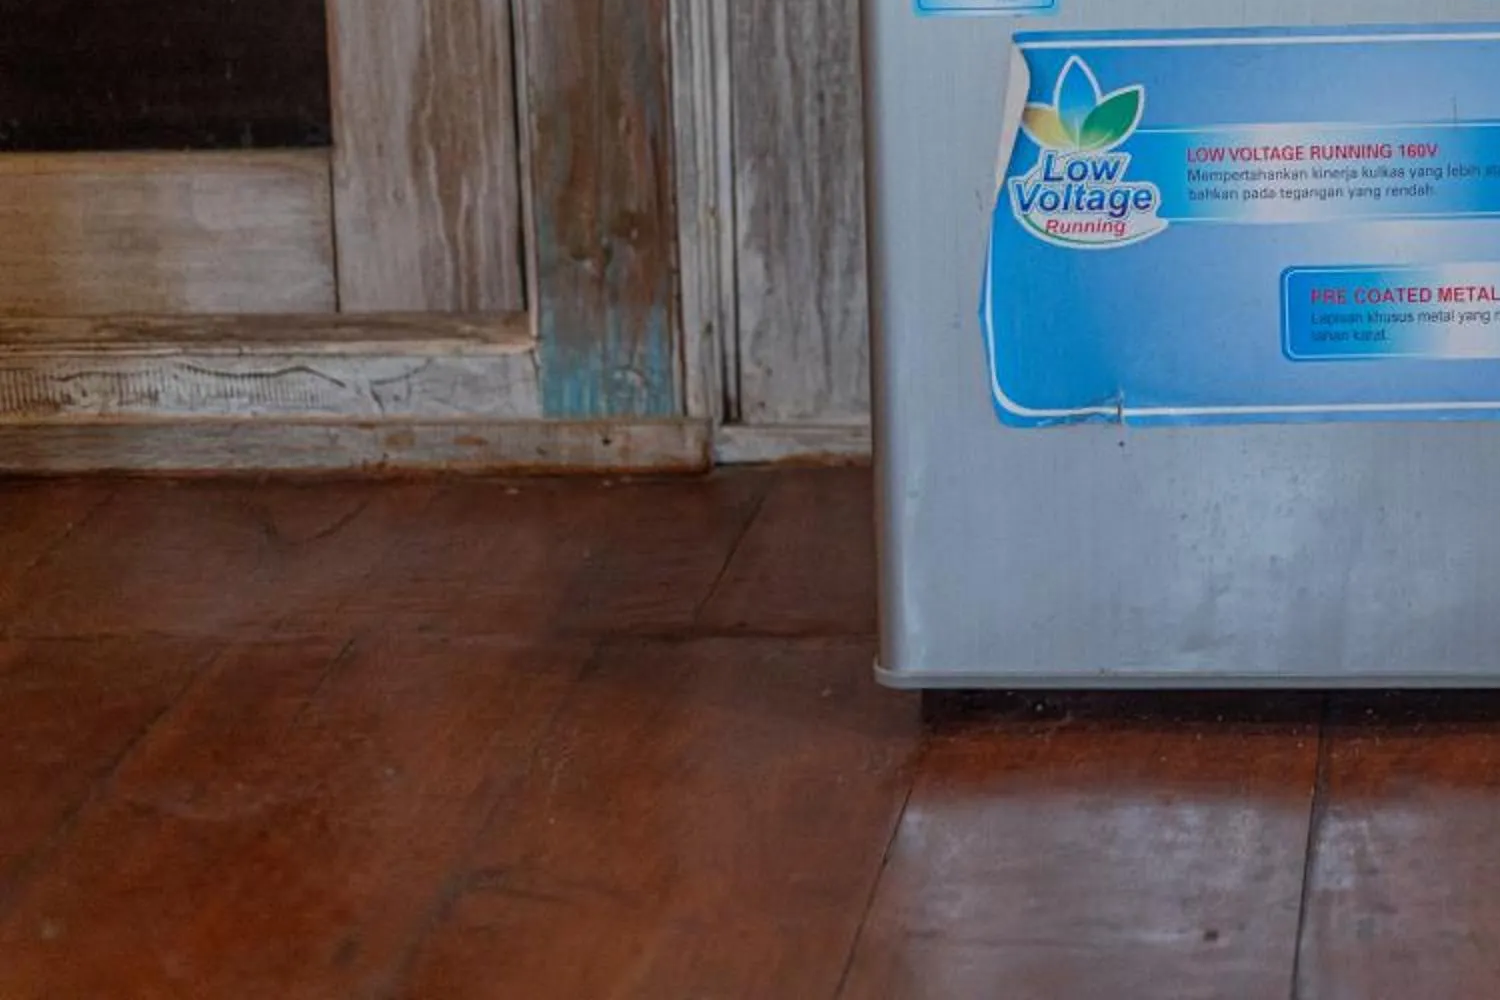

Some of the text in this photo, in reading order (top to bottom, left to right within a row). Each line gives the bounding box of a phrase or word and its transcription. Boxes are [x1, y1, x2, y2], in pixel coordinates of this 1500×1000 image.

[1187, 143, 1439, 164] LOW VOLTAGE RUNNING 160V
[1043, 153, 1121, 183] Low
[1187, 166, 1308, 184] Mempertahankan
[1312, 165, 1359, 182] kinerja
[1361, 165, 1405, 179] kulkas
[1408, 166, 1443, 180] yang
[1014, 182, 1154, 217] Voltage
[1188, 186, 1239, 201] bahkan
[1243, 186, 1277, 202] pada
[1279, 186, 1344, 202] tegangan
[1348, 185, 1381, 200] yang
[1044, 218, 1127, 237] Running
[1310, 288, 1348, 305] PRE
[1354, 287, 1433, 305] COATED
[1367, 309, 1416, 325] khusus
[1417, 308, 1456, 324] metal
[1457, 309, 1491, 325] yang
